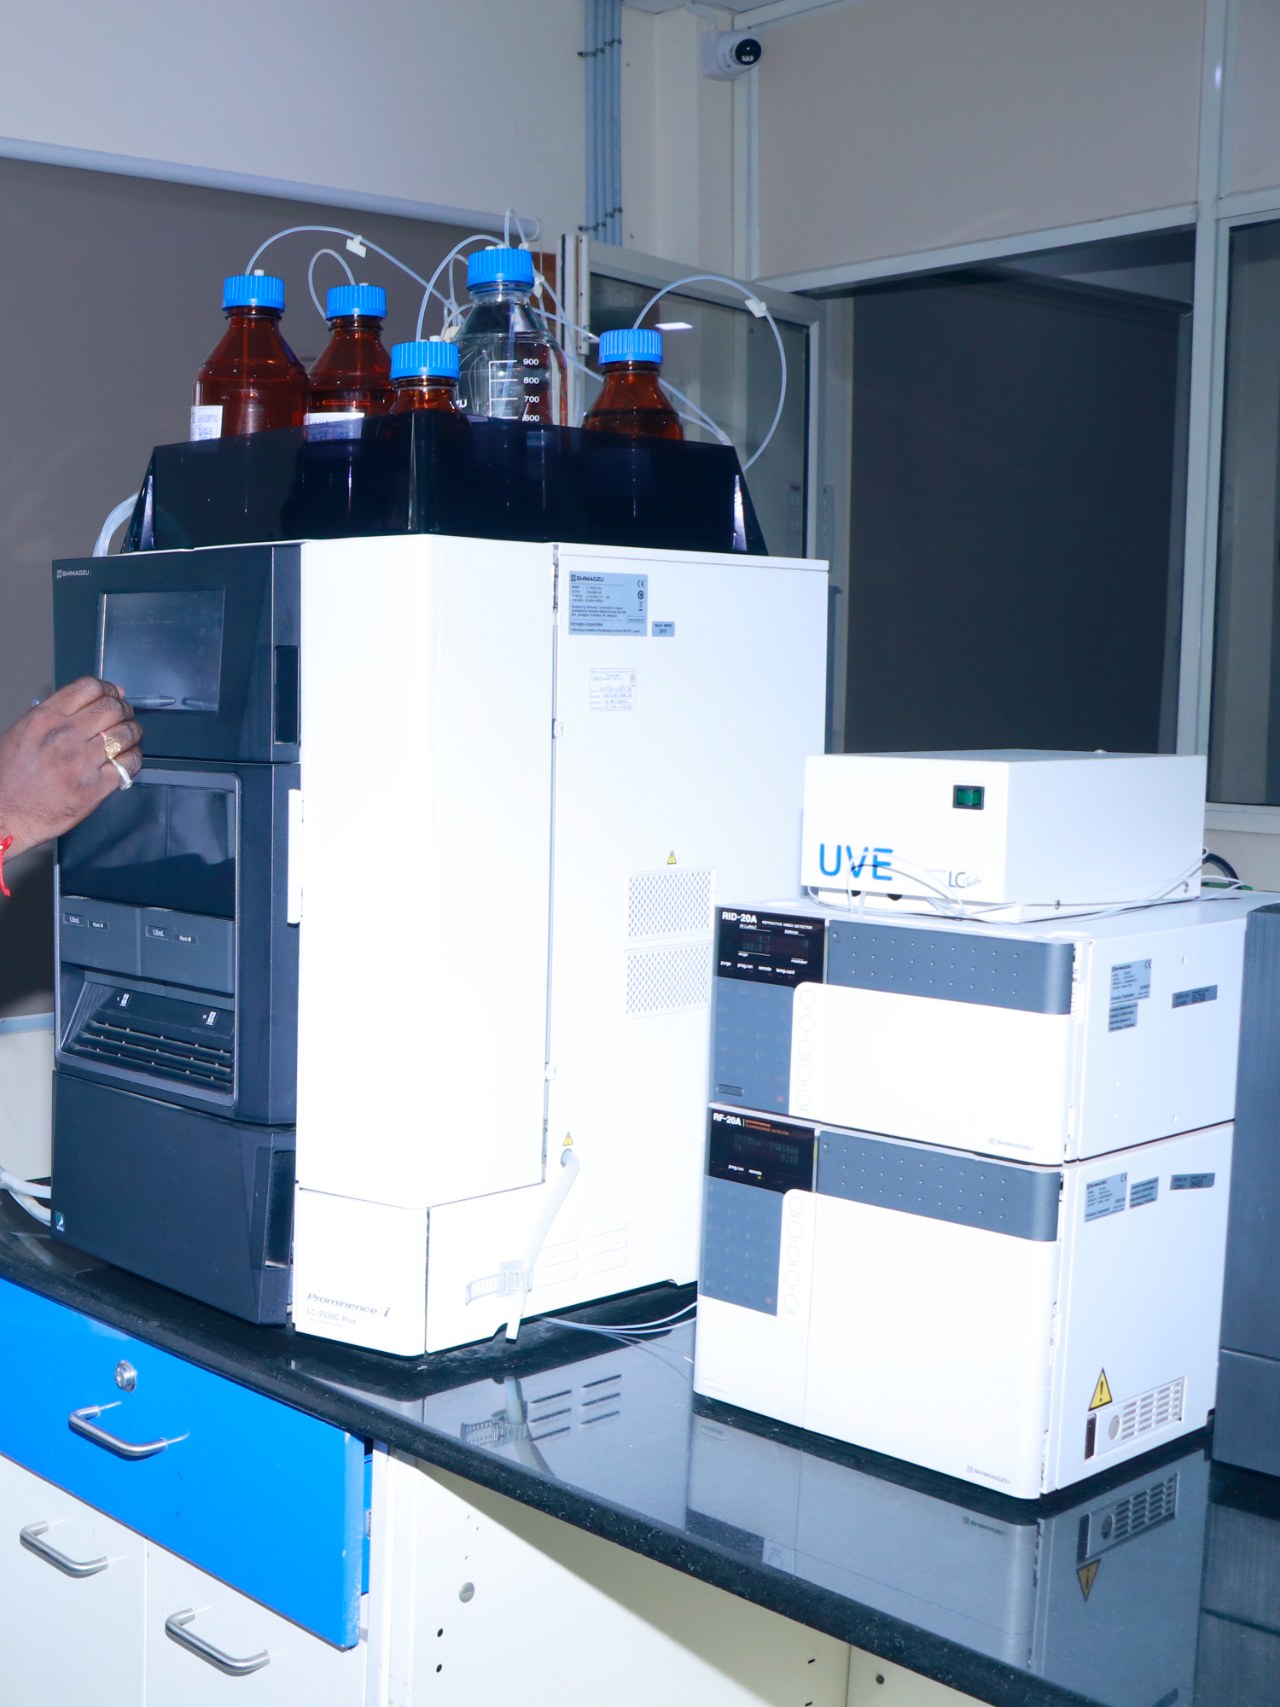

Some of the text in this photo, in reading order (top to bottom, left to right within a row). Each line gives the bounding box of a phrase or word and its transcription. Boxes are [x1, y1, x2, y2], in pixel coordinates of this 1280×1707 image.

[819, 843, 893, 881] UVE
[722, 912, 757, 924] RID-20A
[713, 1112, 741, 1126] RF-20A
[307, 1293, 378, 1314] Prominence
